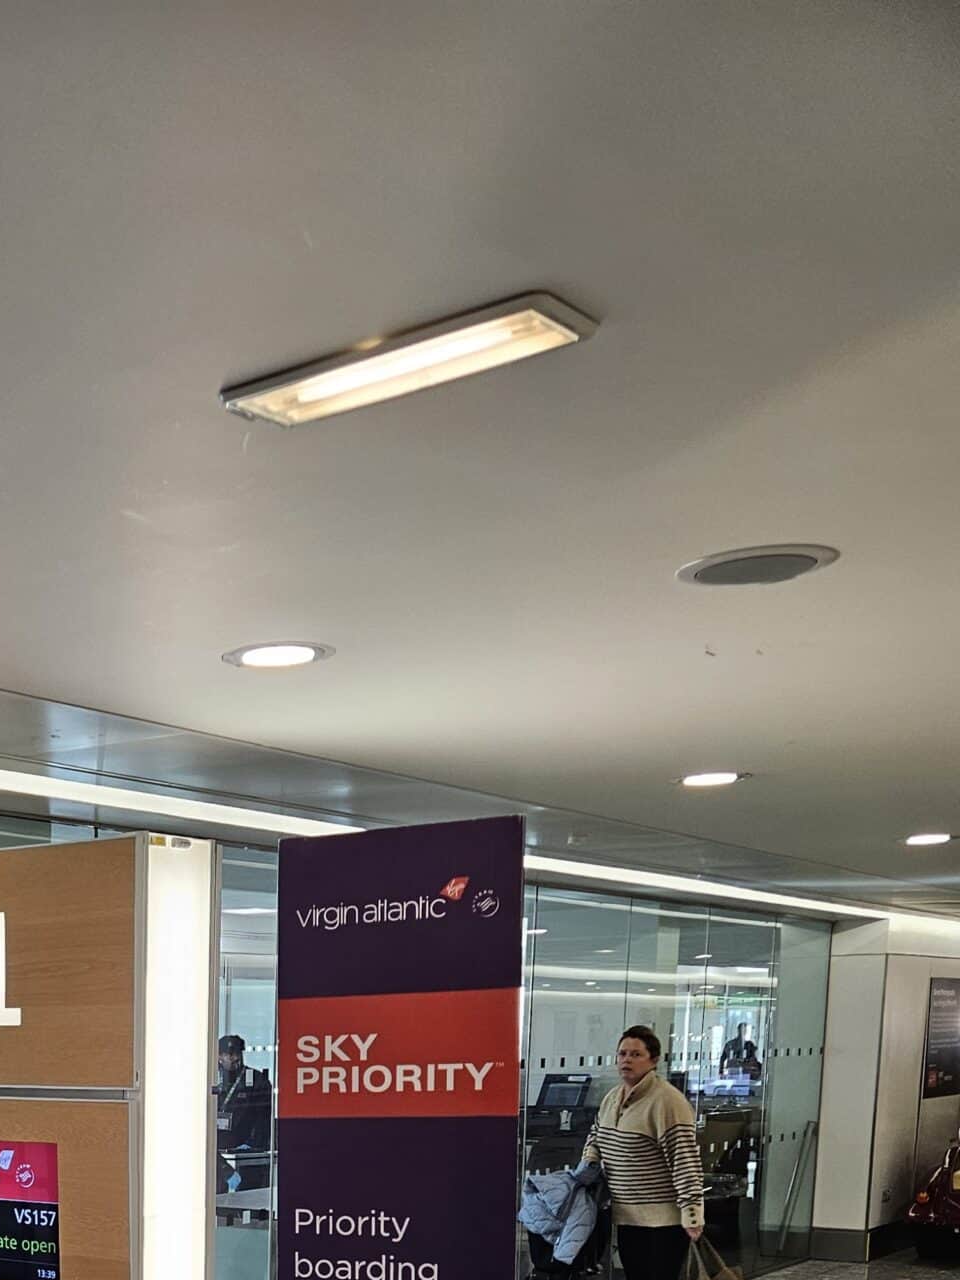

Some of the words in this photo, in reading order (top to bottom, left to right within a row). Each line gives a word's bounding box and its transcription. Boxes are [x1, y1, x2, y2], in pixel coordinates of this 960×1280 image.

[296, 902, 359, 930] virgin
[363, 896, 446, 923] atlantic
[296, 1033, 378, 1063] SKY
[296, 1062, 494, 1094] PRIORITY
[14, 1207, 56, 1226] VS157
[295, 1208, 410, 1242] Priority
[21, 1239, 56, 1255] open
[37, 1269, 56, 1280] 13:39
